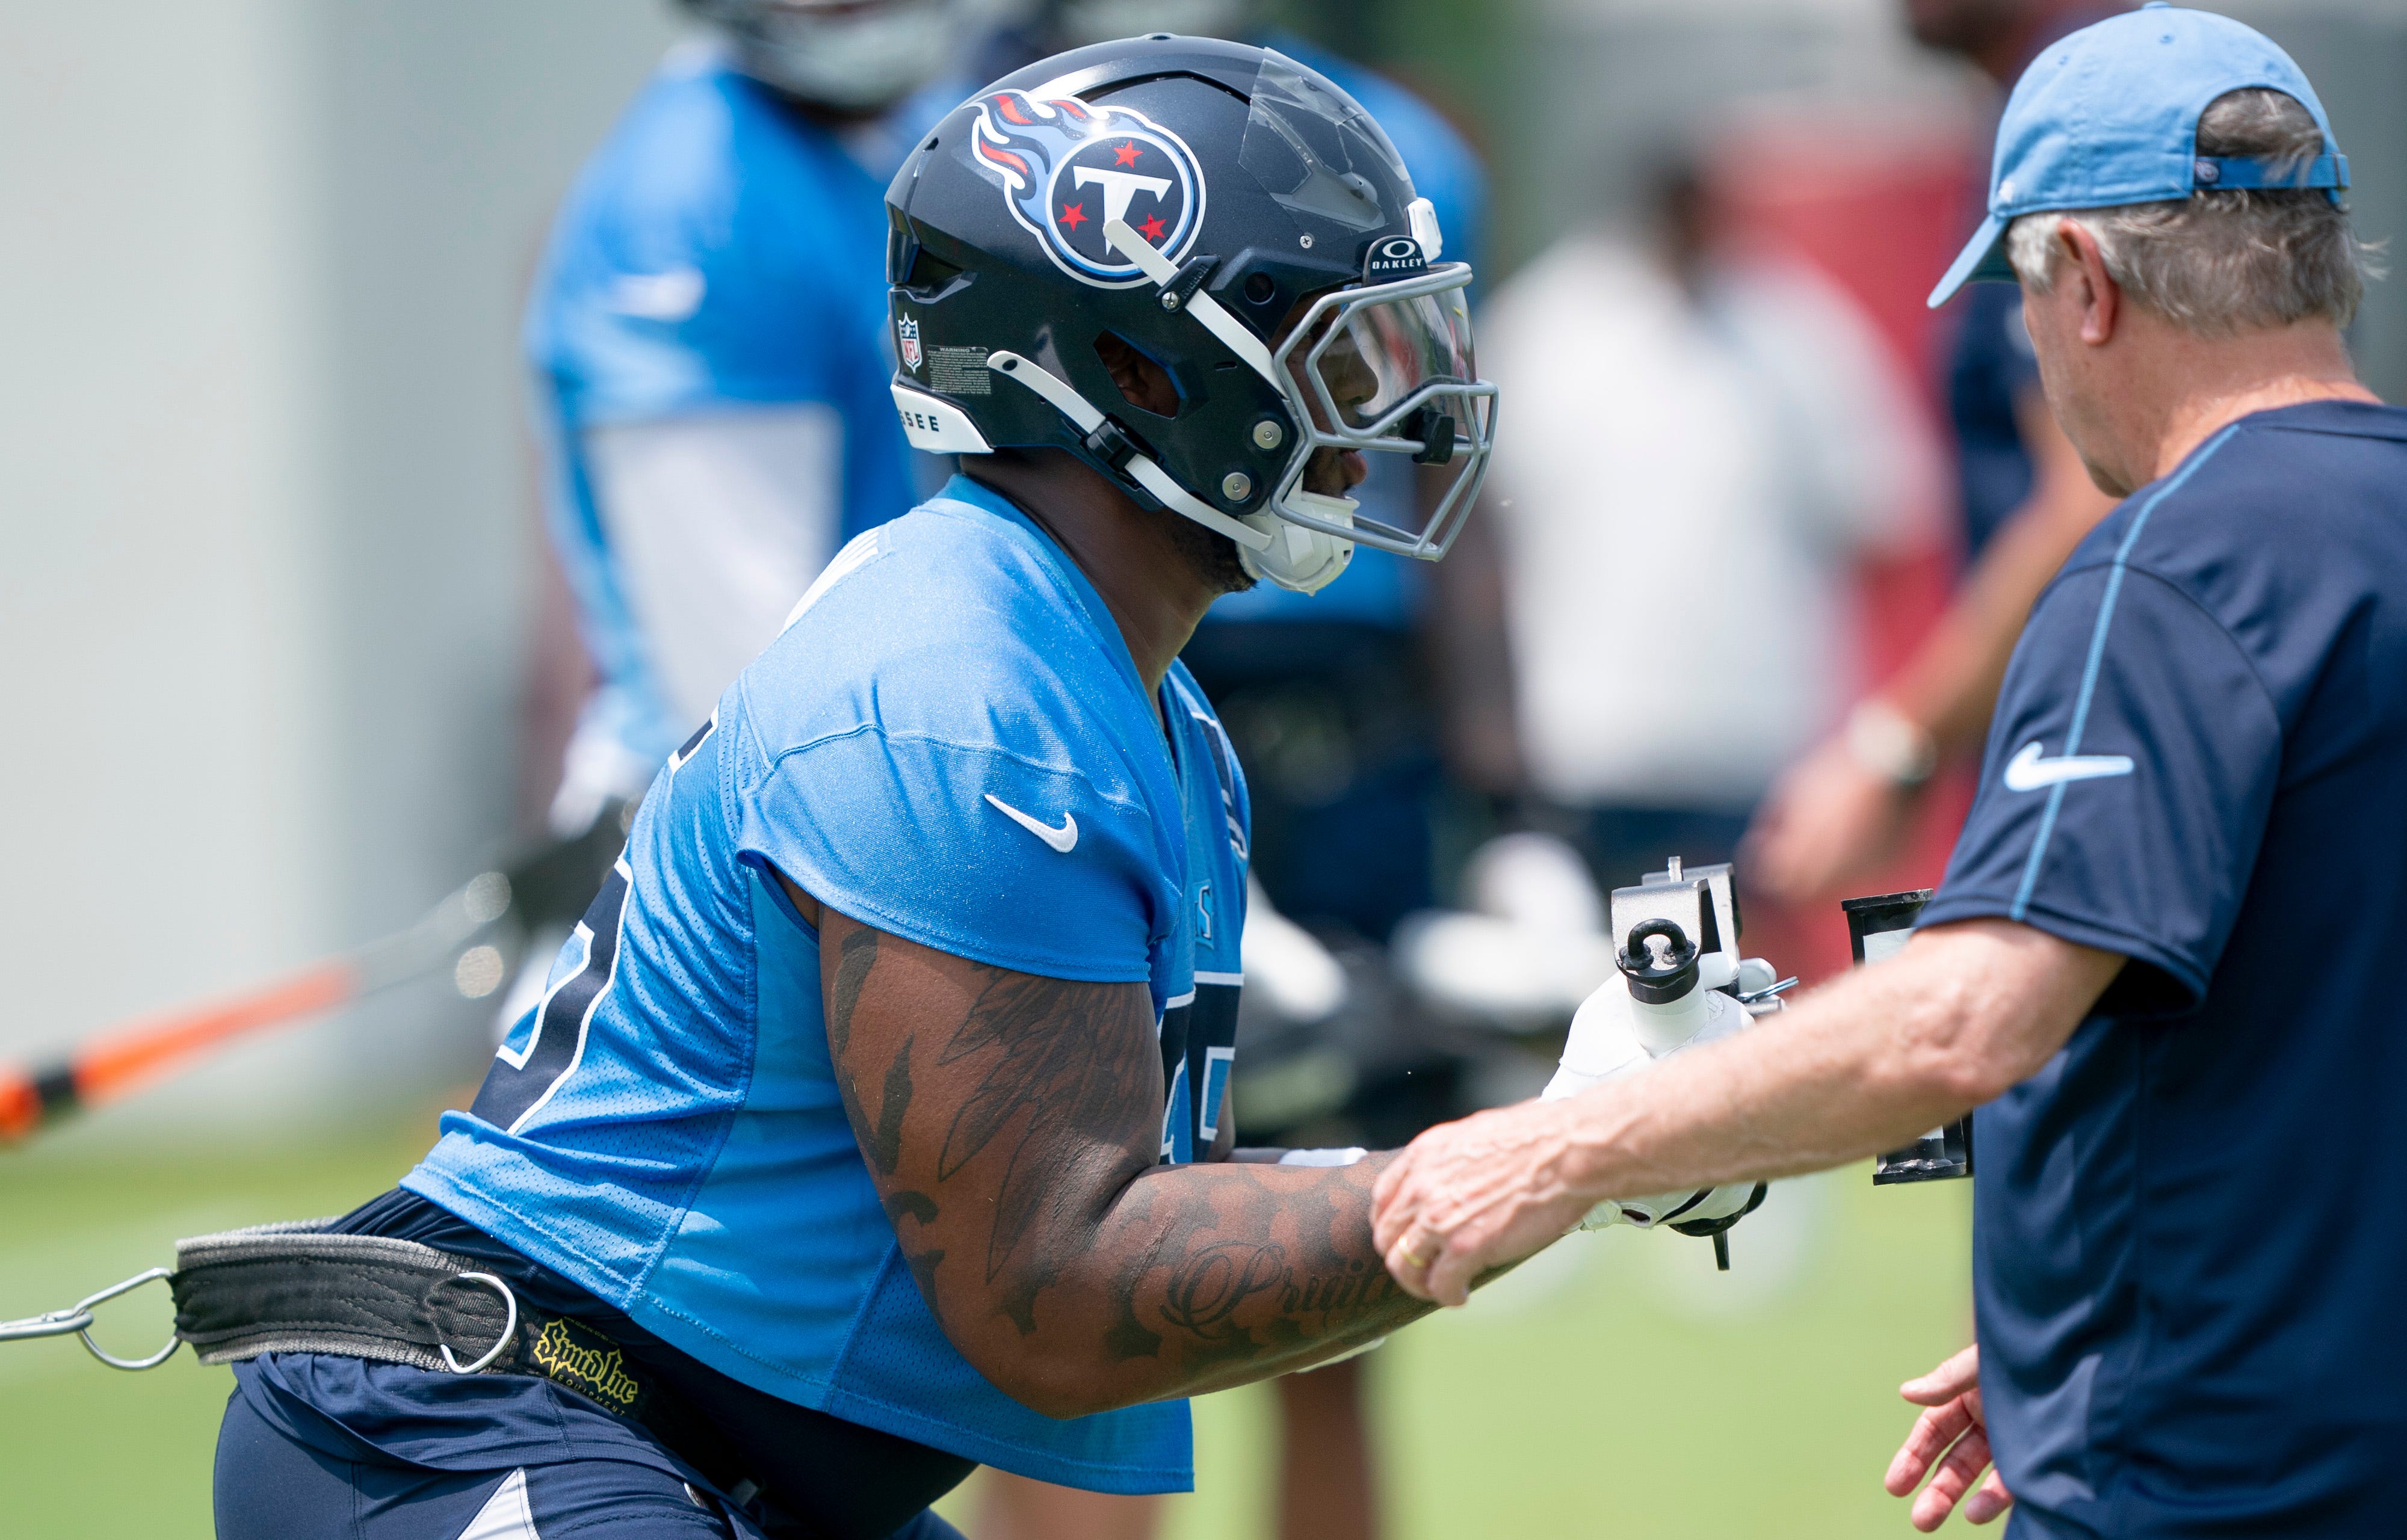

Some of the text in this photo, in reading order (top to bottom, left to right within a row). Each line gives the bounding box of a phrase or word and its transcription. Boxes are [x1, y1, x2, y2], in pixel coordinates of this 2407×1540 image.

[1371, 258, 1423, 270] OAKLEY
[903, 339, 919, 363] NFL
[557, 1374, 625, 1415] EQUIPMENT
